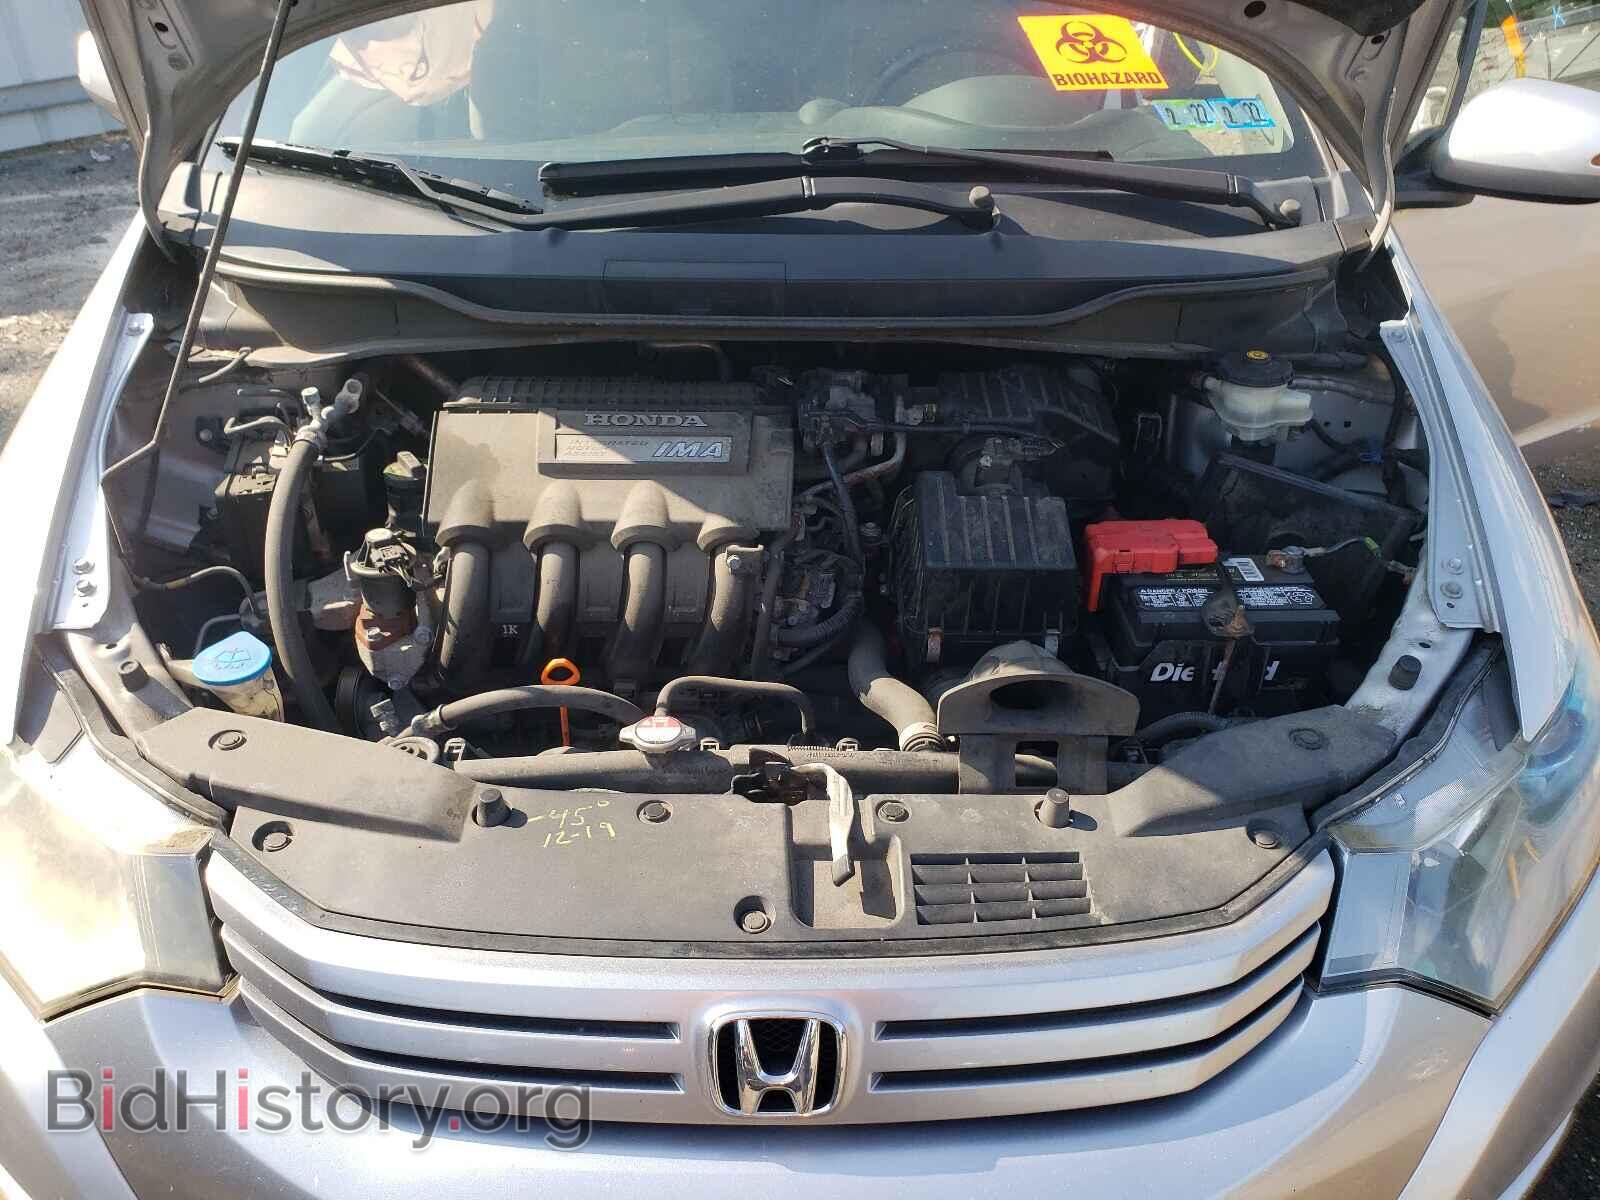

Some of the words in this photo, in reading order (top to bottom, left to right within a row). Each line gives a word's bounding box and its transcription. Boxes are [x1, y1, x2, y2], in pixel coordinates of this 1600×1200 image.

[1053, 72, 1163, 87] BIOHAZARD
[584, 413, 708, 427] HONDA
[653, 442, 723, 458] IMA
